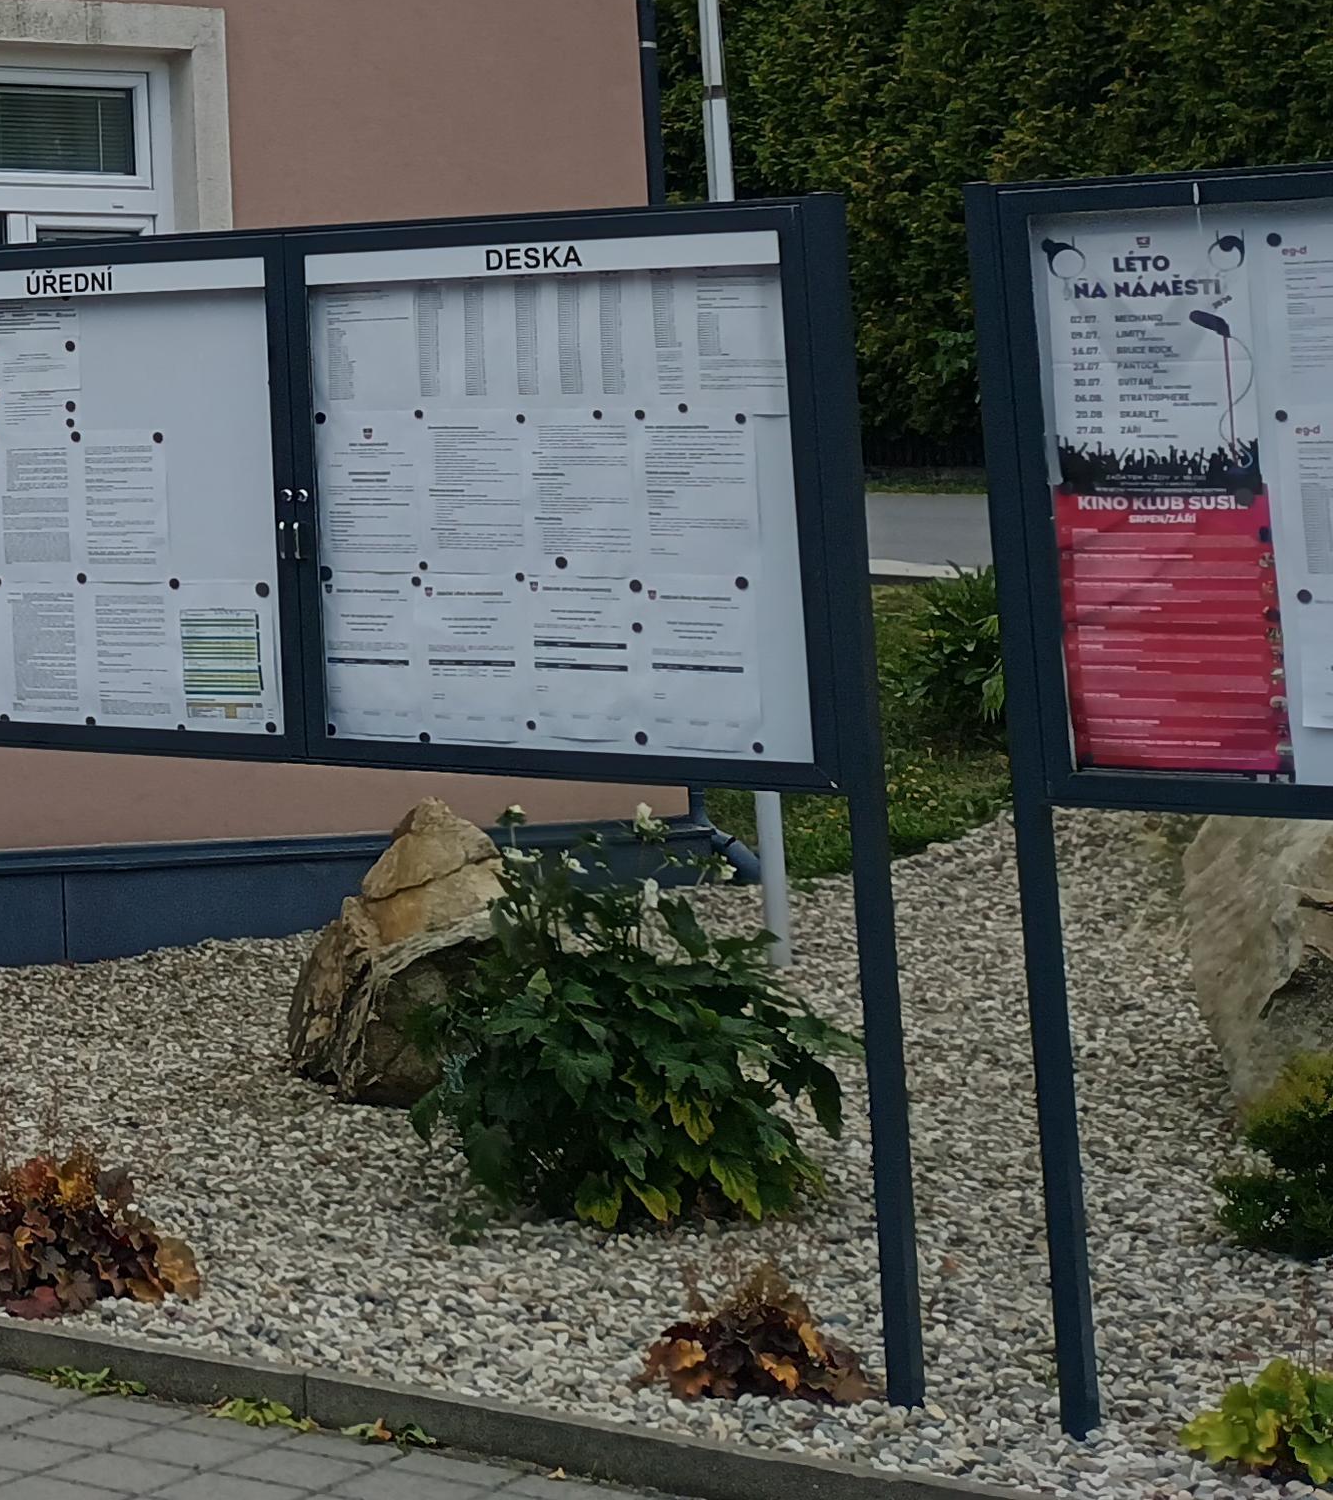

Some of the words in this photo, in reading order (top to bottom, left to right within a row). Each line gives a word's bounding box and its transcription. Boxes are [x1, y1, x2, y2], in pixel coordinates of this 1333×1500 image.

[485, 245, 583, 272] DESKA
[1112, 250, 1171, 273] LÉTO
[25, 265, 114, 296] ÚŘEDNÍ
[1073, 281, 1108, 299] NA
[1077, 495, 1129, 510] KINO
[1133, 496, 1185, 510] KLUB
